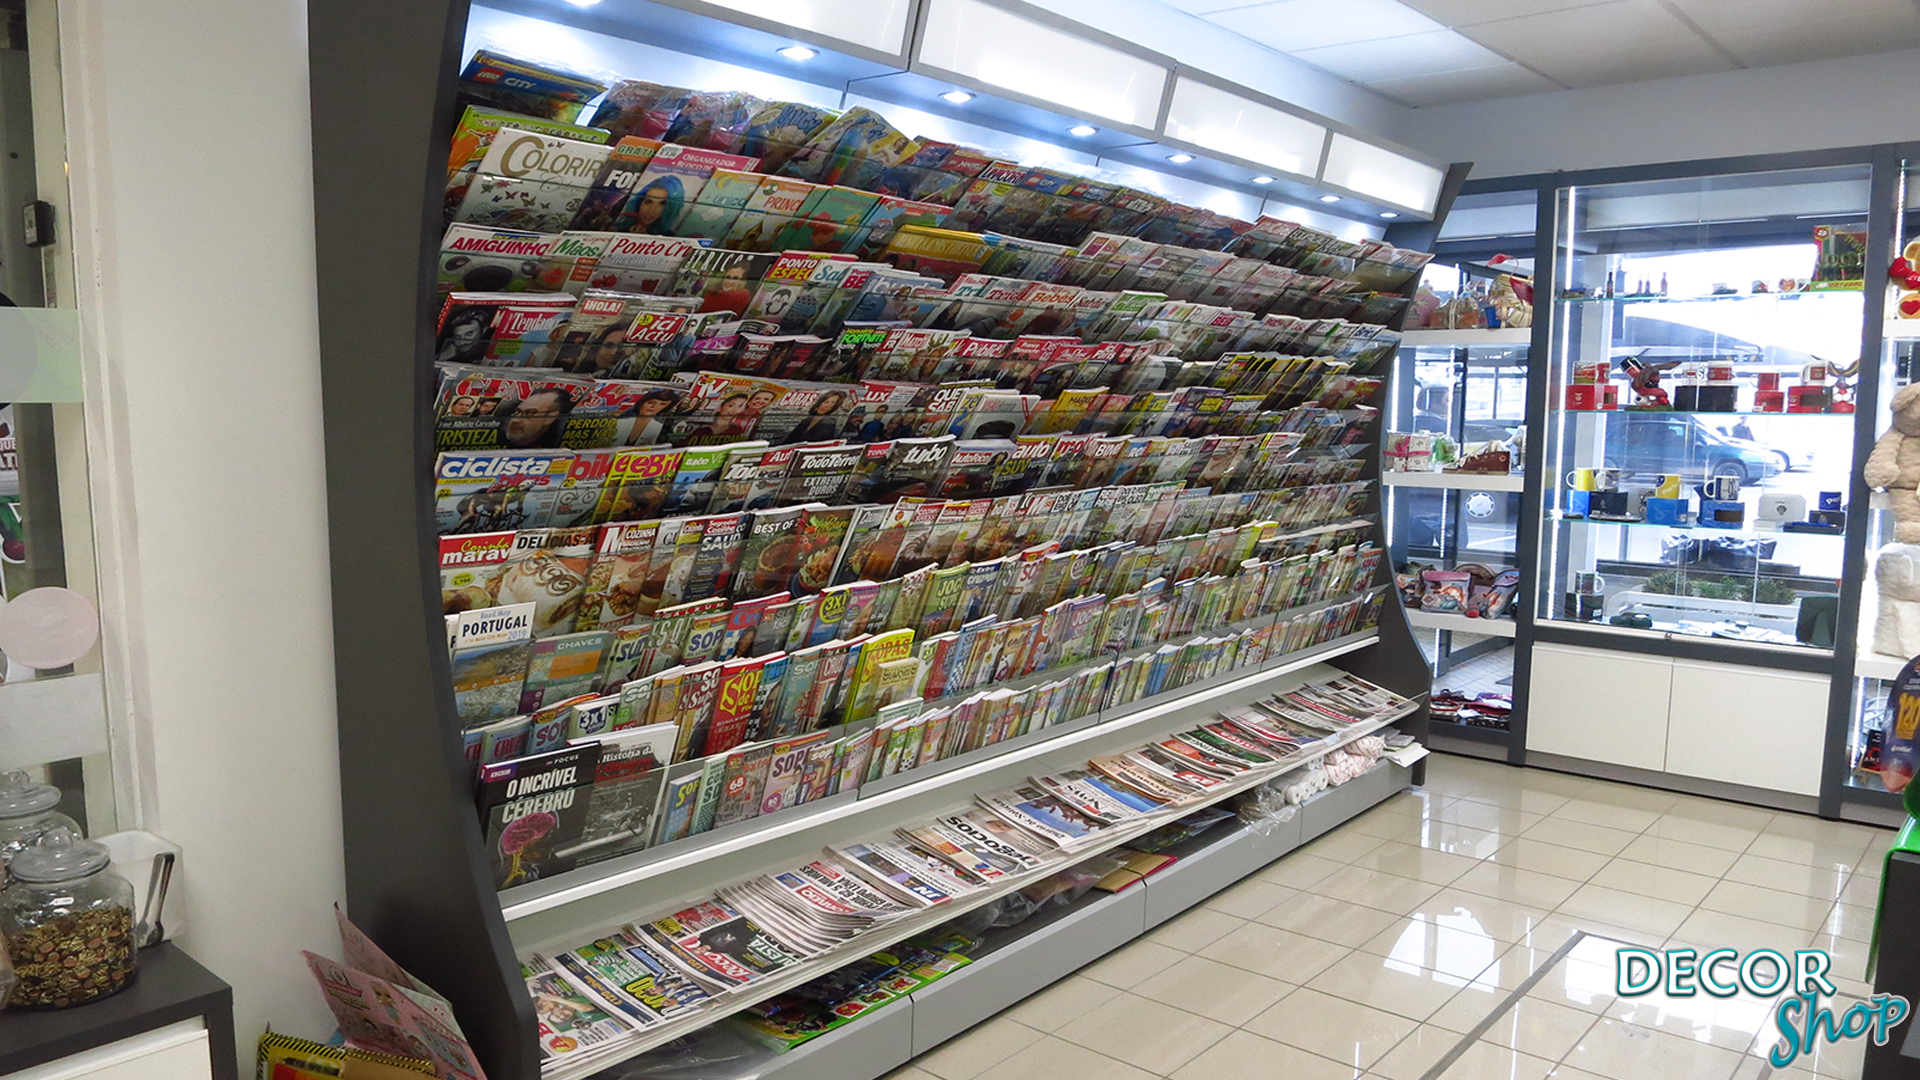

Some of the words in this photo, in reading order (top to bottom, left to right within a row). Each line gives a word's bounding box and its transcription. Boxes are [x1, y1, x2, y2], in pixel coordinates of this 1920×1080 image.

[504, 77, 537, 89] CITY
[611, 238, 662, 256] Ponto
[902, 445, 948, 464] turbo
[1012, 440, 1051, 458] auto
[441, 457, 551, 478] ciclista
[754, 522, 781, 535] BEST
[782, 518, 794, 530] OF
[462, 615, 528, 637] PORTUGAL
[508, 629, 527, 640] 2019
[557, 637, 603, 651] CHAVES
[553, 754, 580, 765] FOCUS
[602, 749, 639, 764] História
[506, 780, 516, 799] O
[517, 766, 578, 796] INCRÍVEL
[728, 778, 745, 792] 68
[502, 788, 576, 824] CÉREBRO
